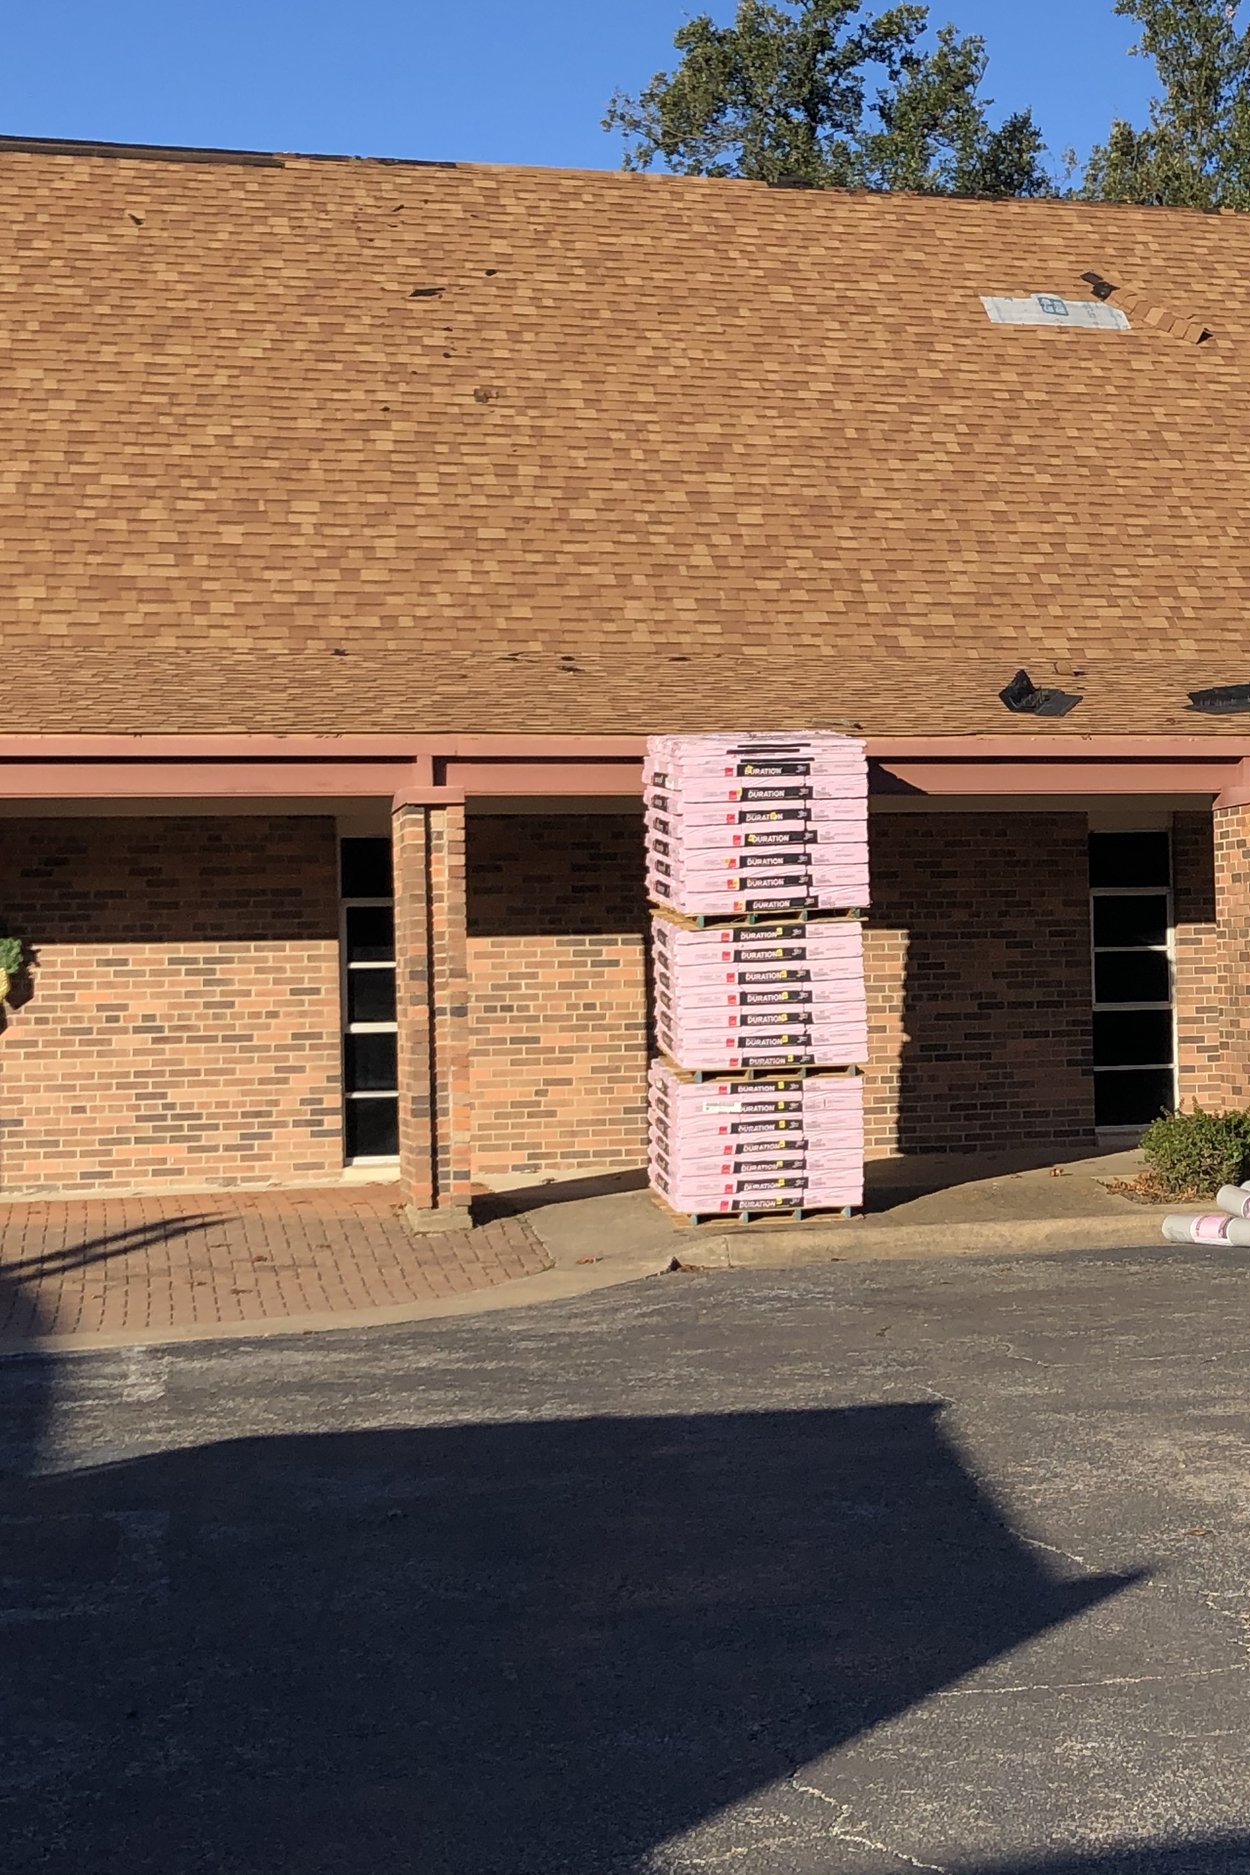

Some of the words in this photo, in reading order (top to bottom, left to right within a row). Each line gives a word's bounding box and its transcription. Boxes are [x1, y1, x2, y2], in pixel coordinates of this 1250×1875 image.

[748, 790, 785, 798] DURATION
[746, 813, 783, 821] DURATN
[747, 879, 784, 887] DURATION
[753, 900, 790, 908] DURATION
[741, 932, 777, 940] DURATION
[739, 1200, 776, 1208] DURATION
